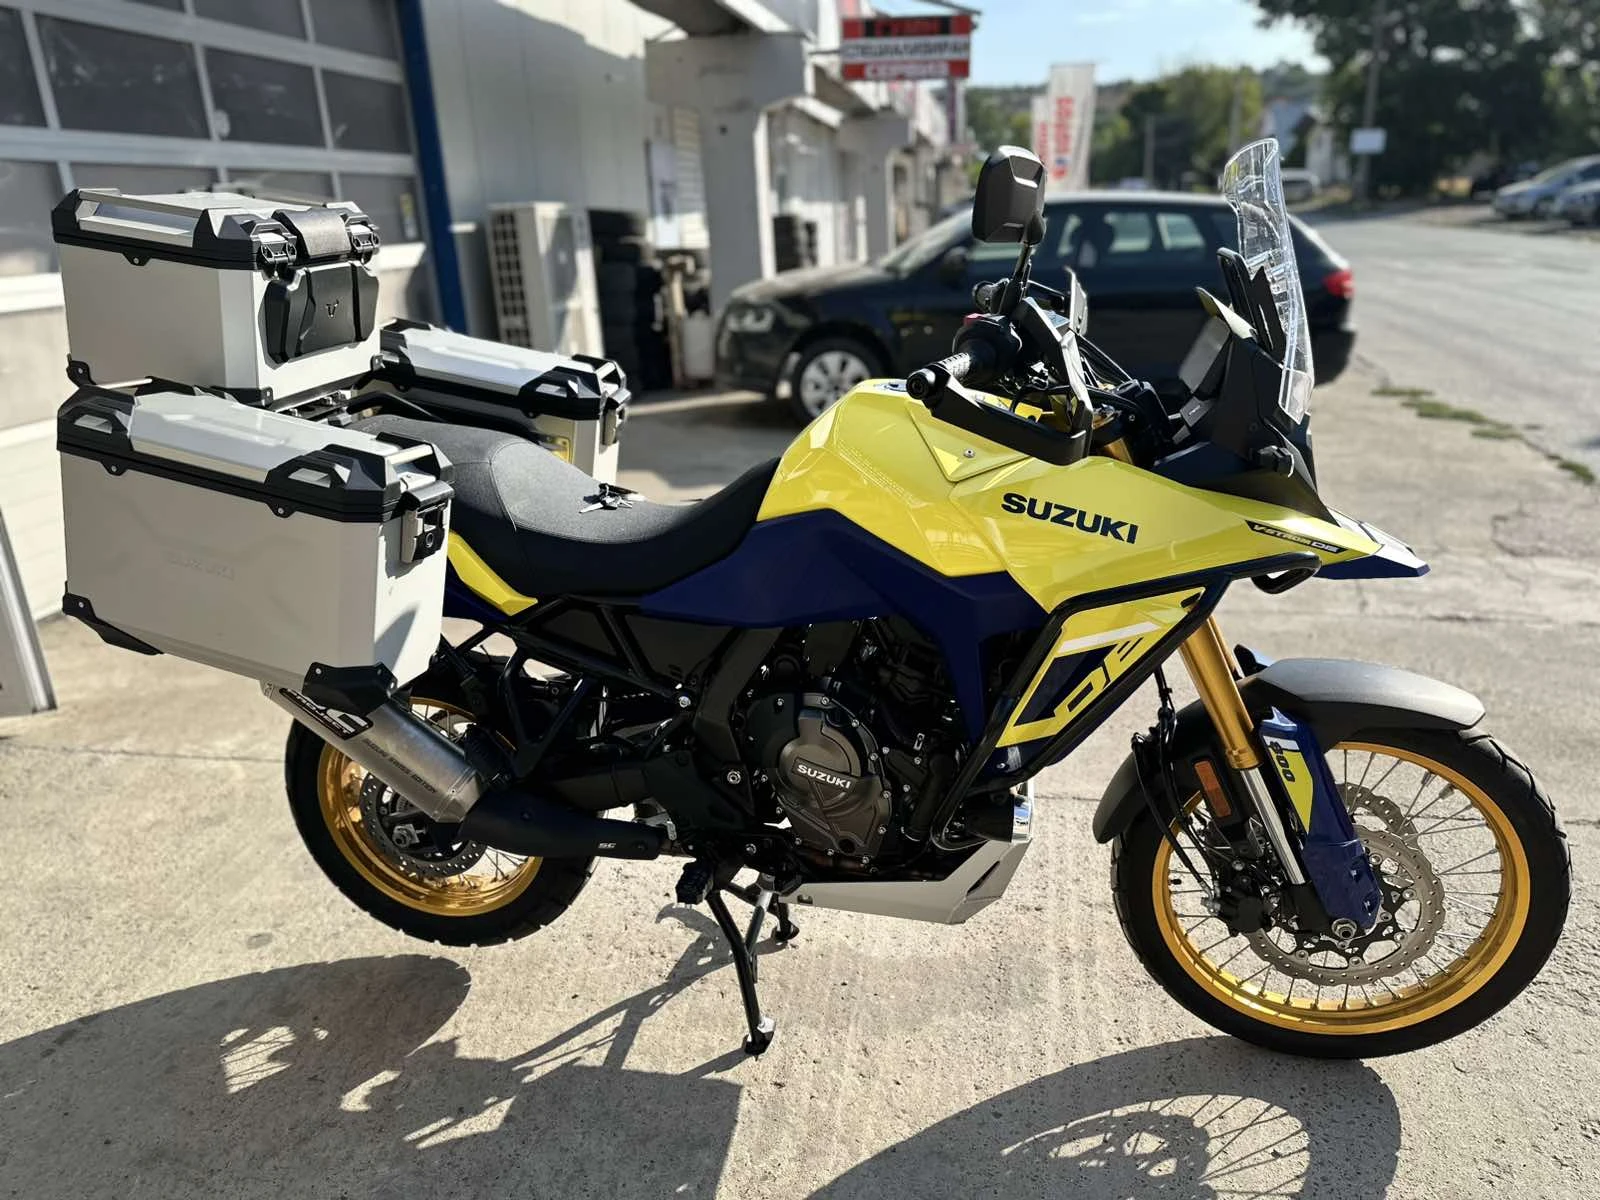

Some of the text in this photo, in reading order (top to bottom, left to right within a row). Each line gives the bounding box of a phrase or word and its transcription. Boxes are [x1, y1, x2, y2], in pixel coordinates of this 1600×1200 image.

[1001, 492, 1139, 544] SUZUKI
[1311, 541, 1340, 554] DE
[286, 688, 352, 735] PROJECT
[797, 764, 852, 789] SUZUKI
[1269, 741, 1296, 783] 800
